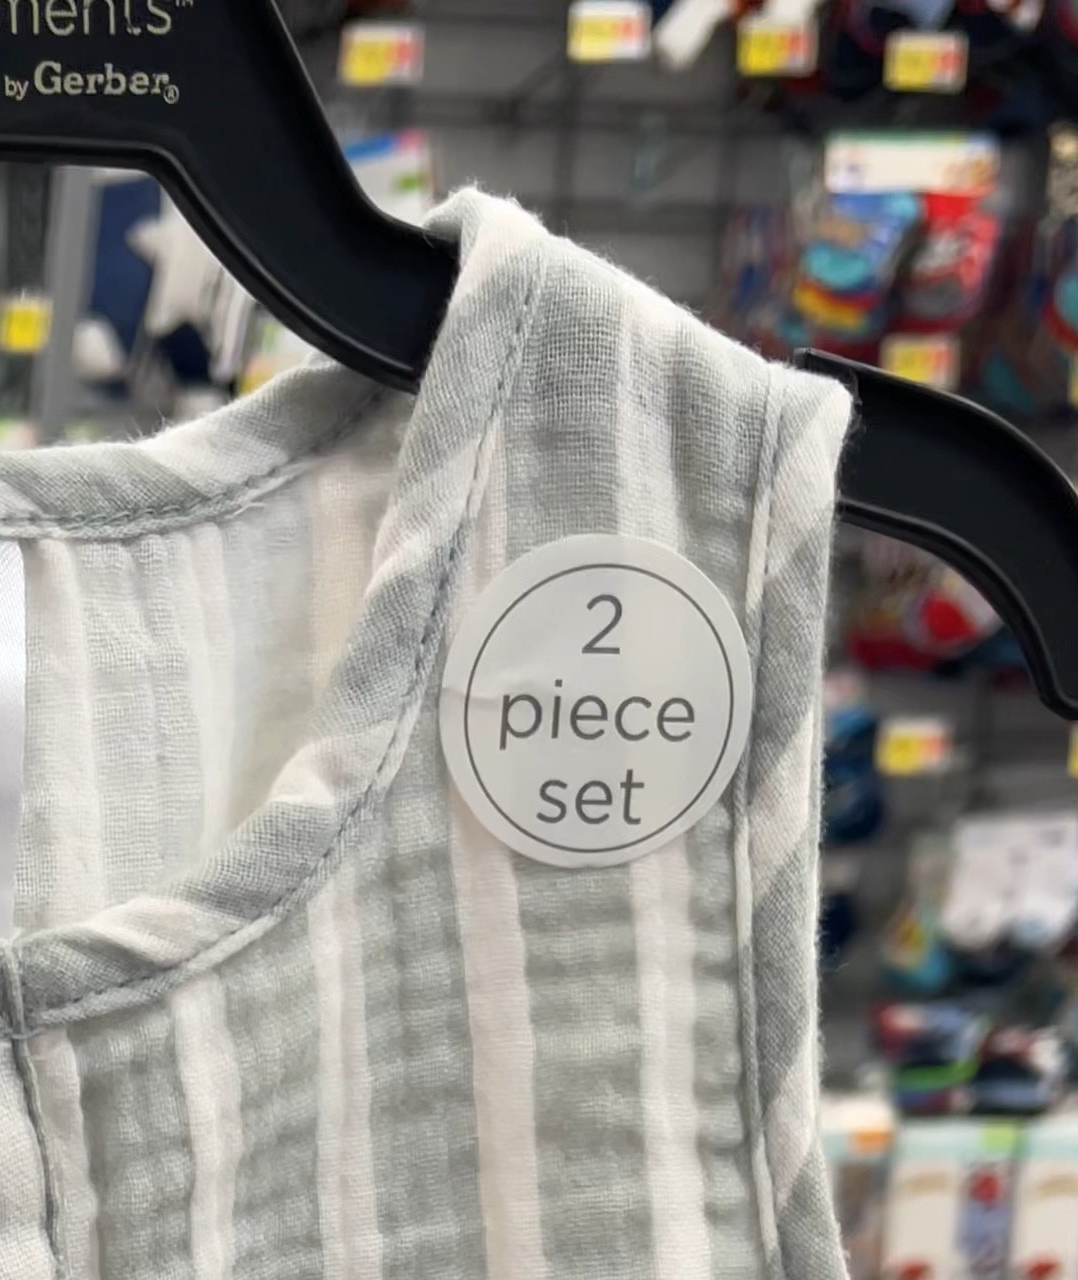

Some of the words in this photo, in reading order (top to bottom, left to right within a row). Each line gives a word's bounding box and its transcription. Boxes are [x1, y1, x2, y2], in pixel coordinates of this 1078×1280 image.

[4, 74, 30, 101] by
[581, 593, 623, 655] 2
[499, 678, 696, 751] piece
[536, 768, 645, 825] set
